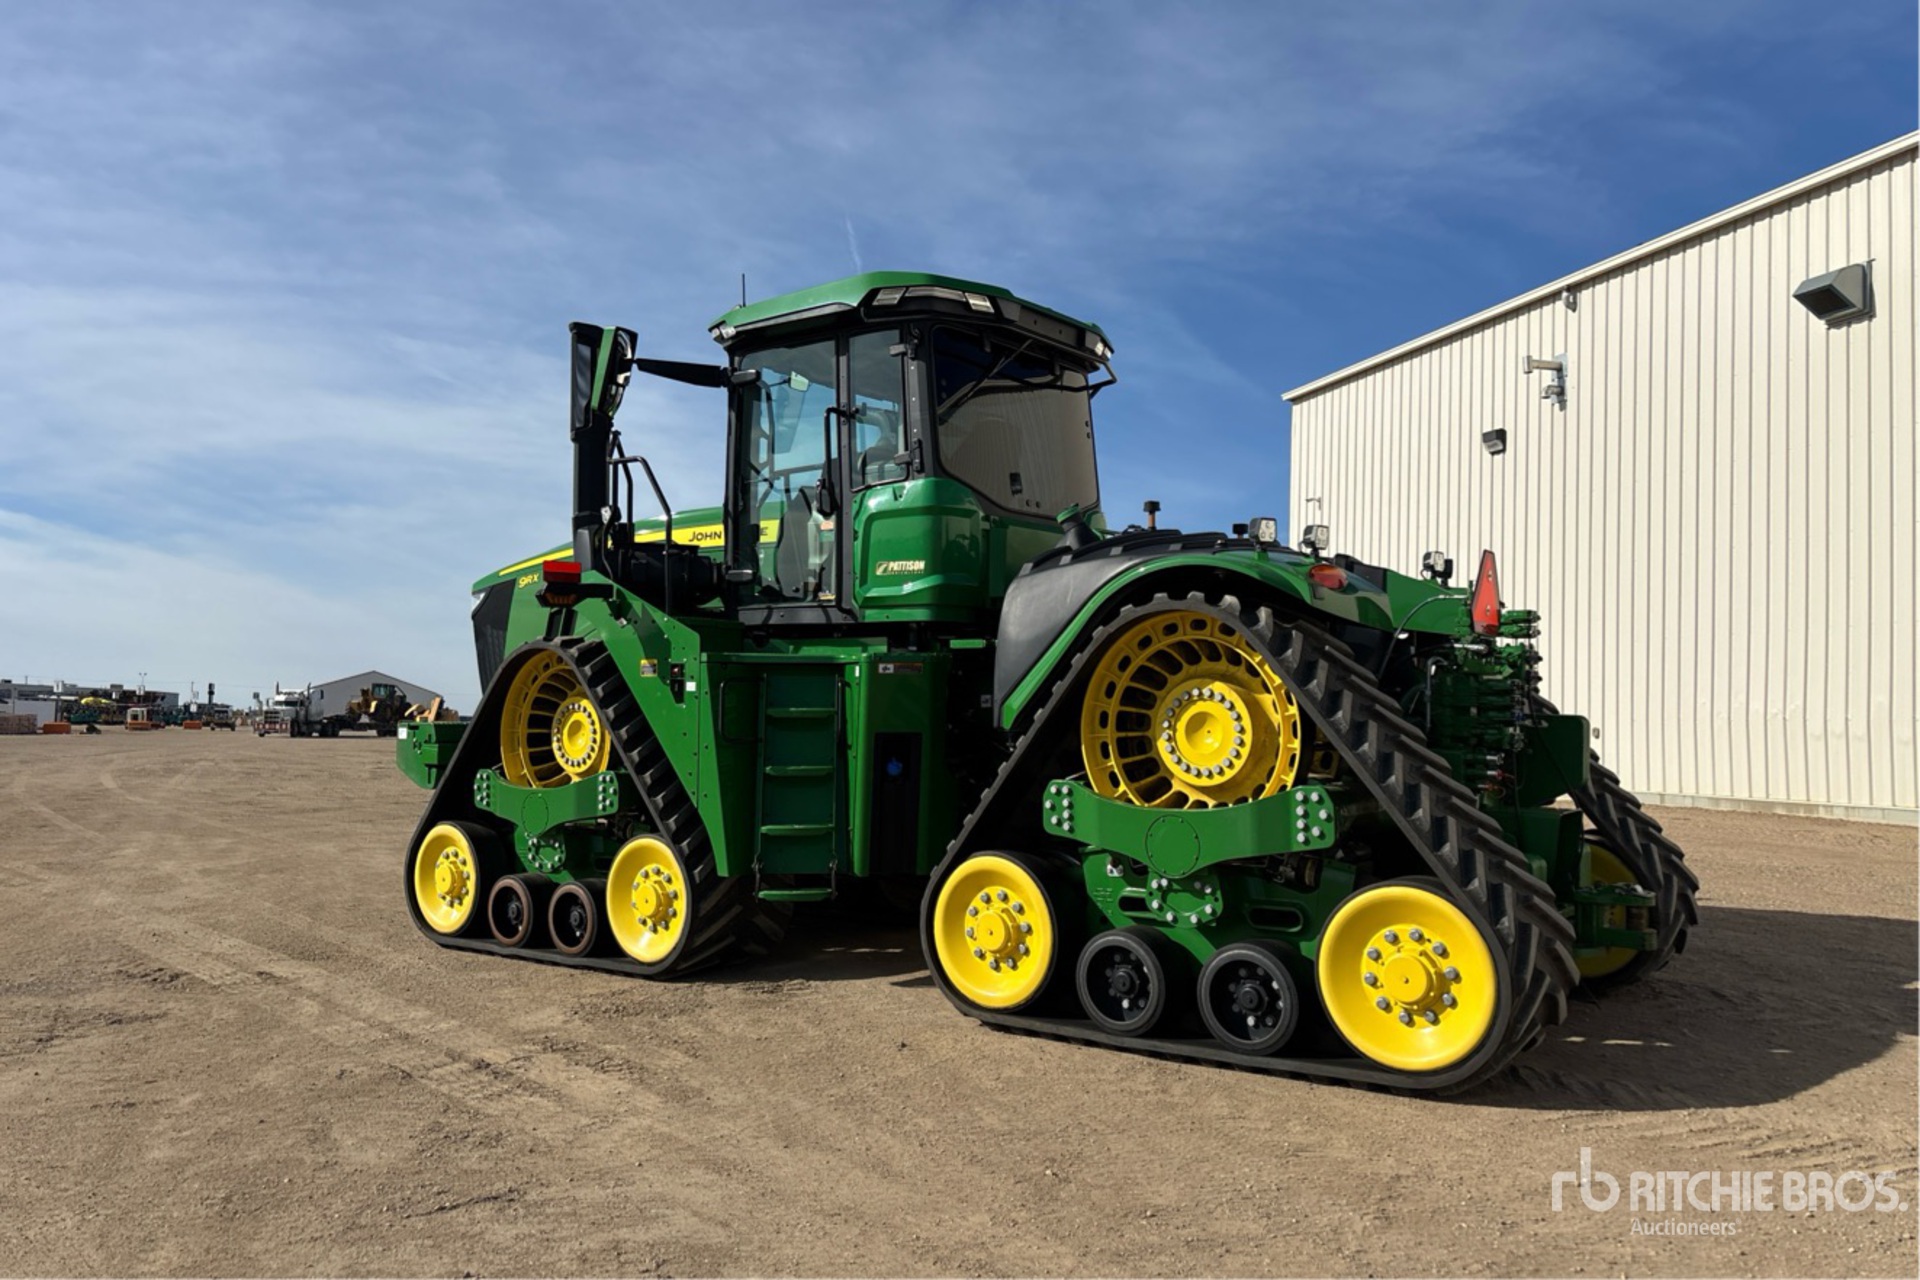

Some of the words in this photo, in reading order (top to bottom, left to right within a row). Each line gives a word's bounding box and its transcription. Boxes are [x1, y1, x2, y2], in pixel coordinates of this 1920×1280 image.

[688, 531, 722, 542] JOHN
[889, 560, 926, 571] PATTISON
[518, 573, 539, 588] 9RX
